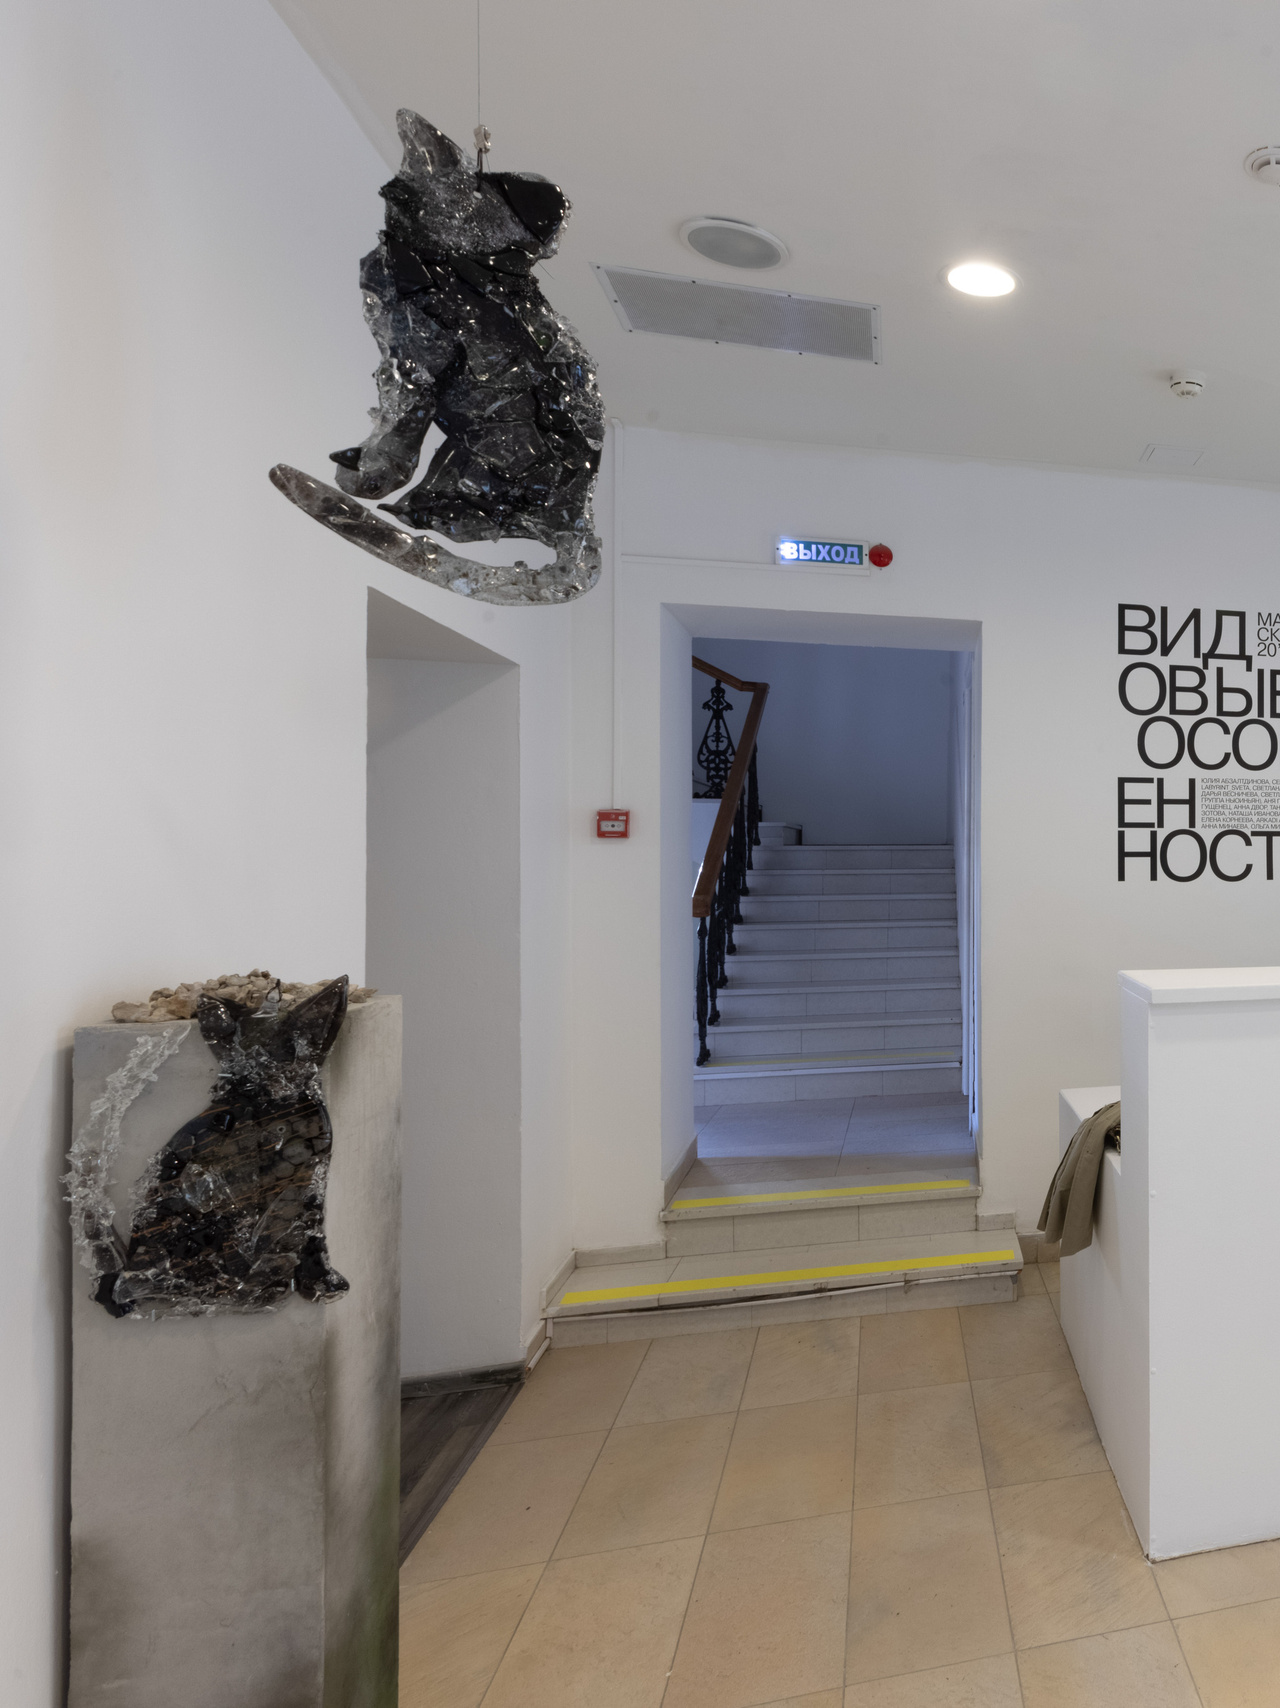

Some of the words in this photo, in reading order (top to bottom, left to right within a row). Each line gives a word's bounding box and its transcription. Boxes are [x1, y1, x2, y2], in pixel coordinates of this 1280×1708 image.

[781, 541, 860, 564] ВЫХОД
[1118, 603, 1252, 672] ВИД
[1118, 777, 1196, 829] ЕН
